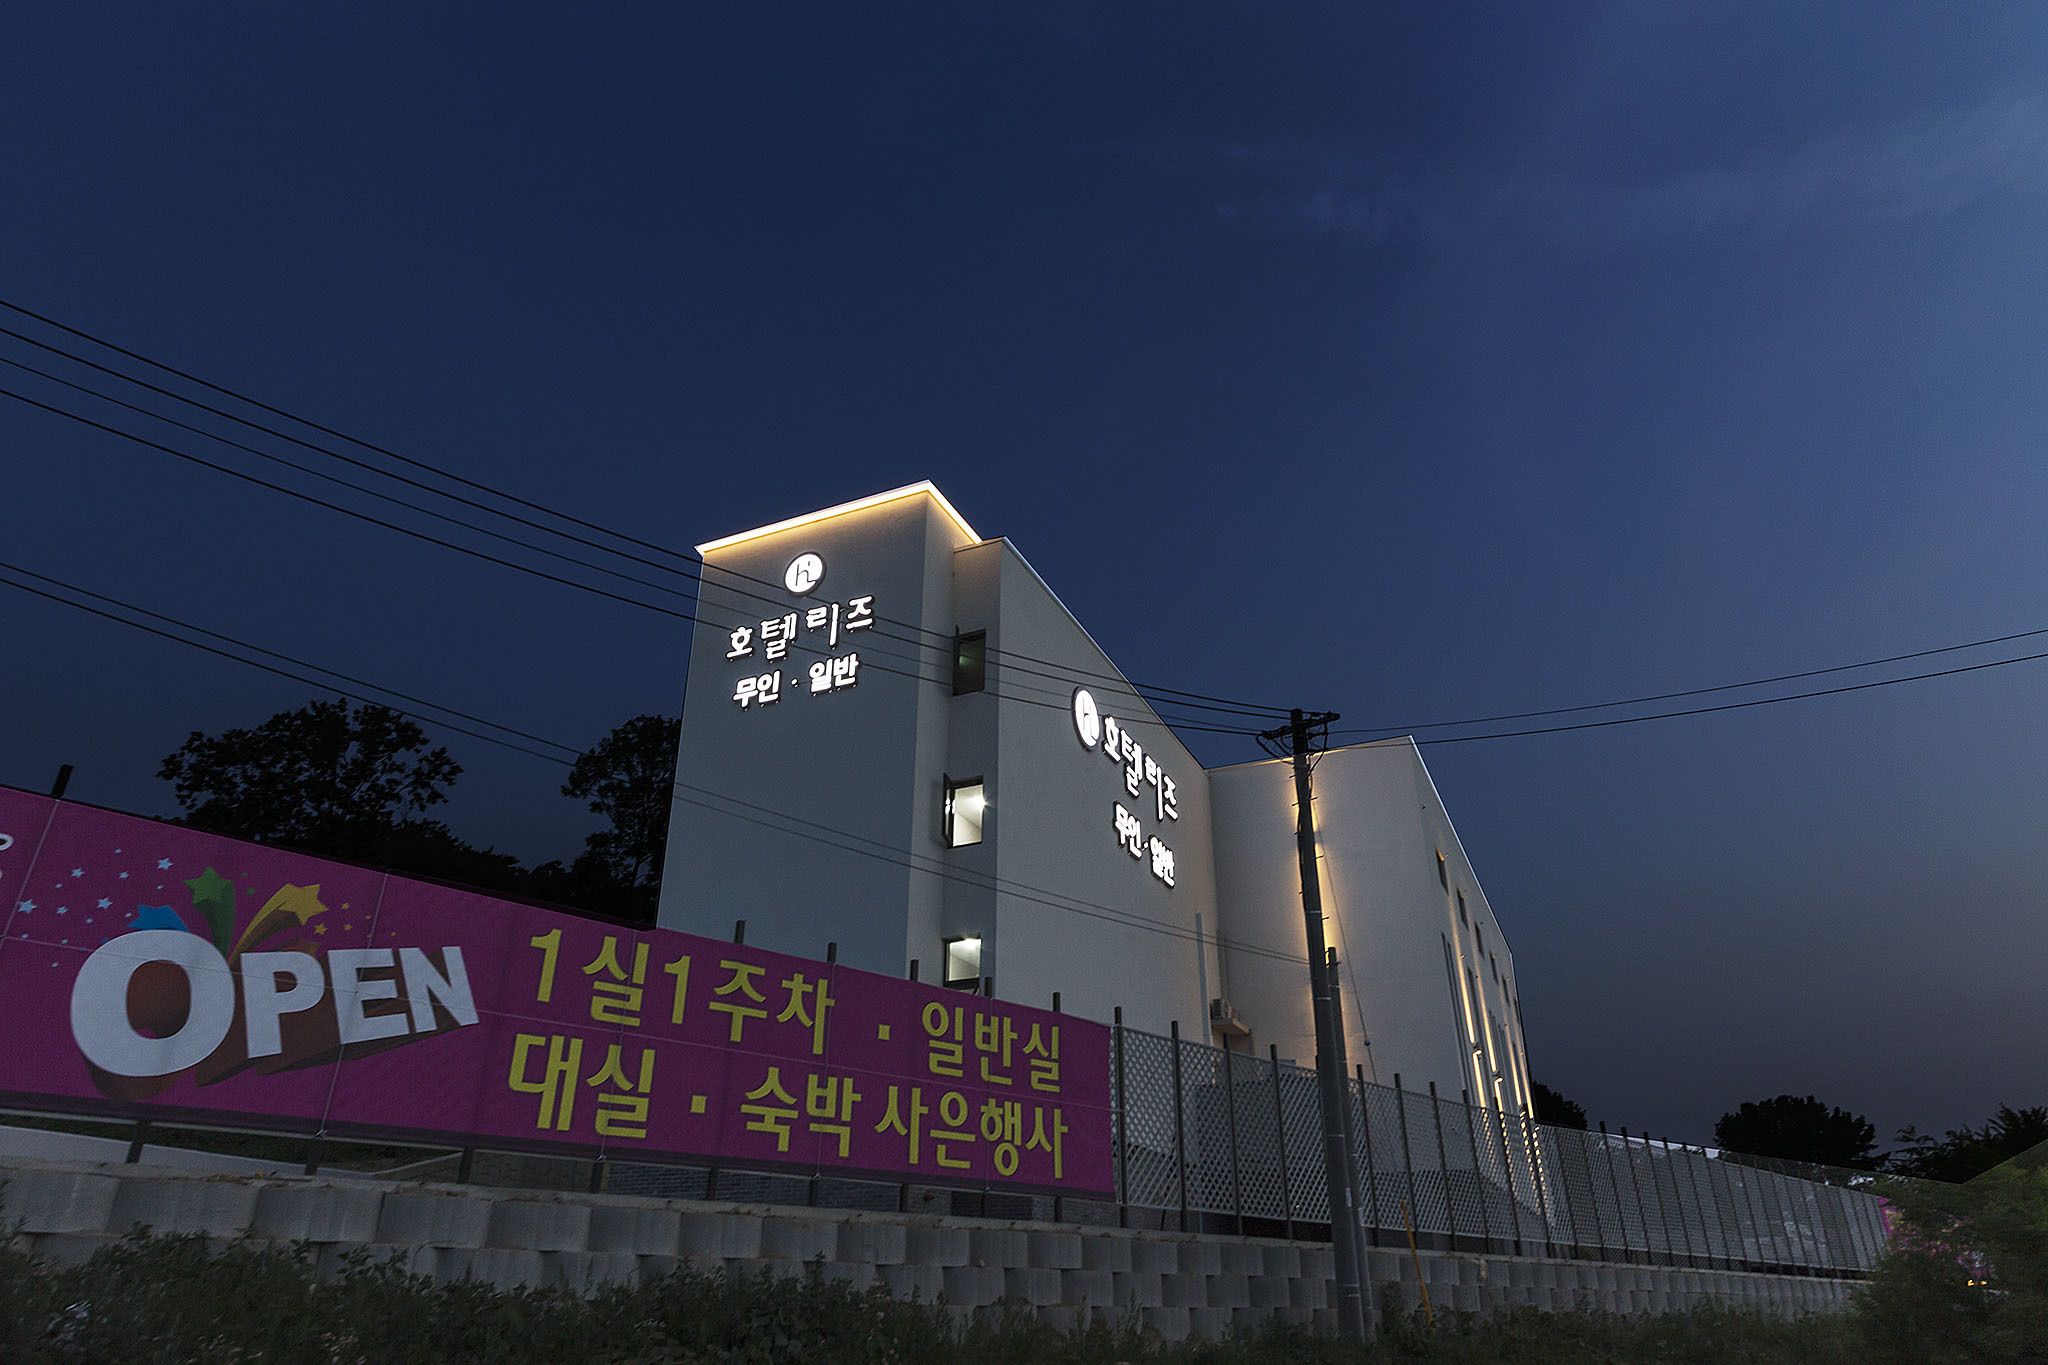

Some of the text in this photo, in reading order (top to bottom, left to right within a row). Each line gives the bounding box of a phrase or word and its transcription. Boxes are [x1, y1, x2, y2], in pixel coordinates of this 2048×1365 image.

[733, 670, 781, 708] 무인
[809, 653, 860, 693] 일반
[1115, 803, 1143, 858] 무인
[1150, 836, 1176, 887] 일반
[70, 928, 481, 1078] OPEN
[922, 1001, 1062, 1094] 일반실
[507, 1033, 657, 1139] 대실
